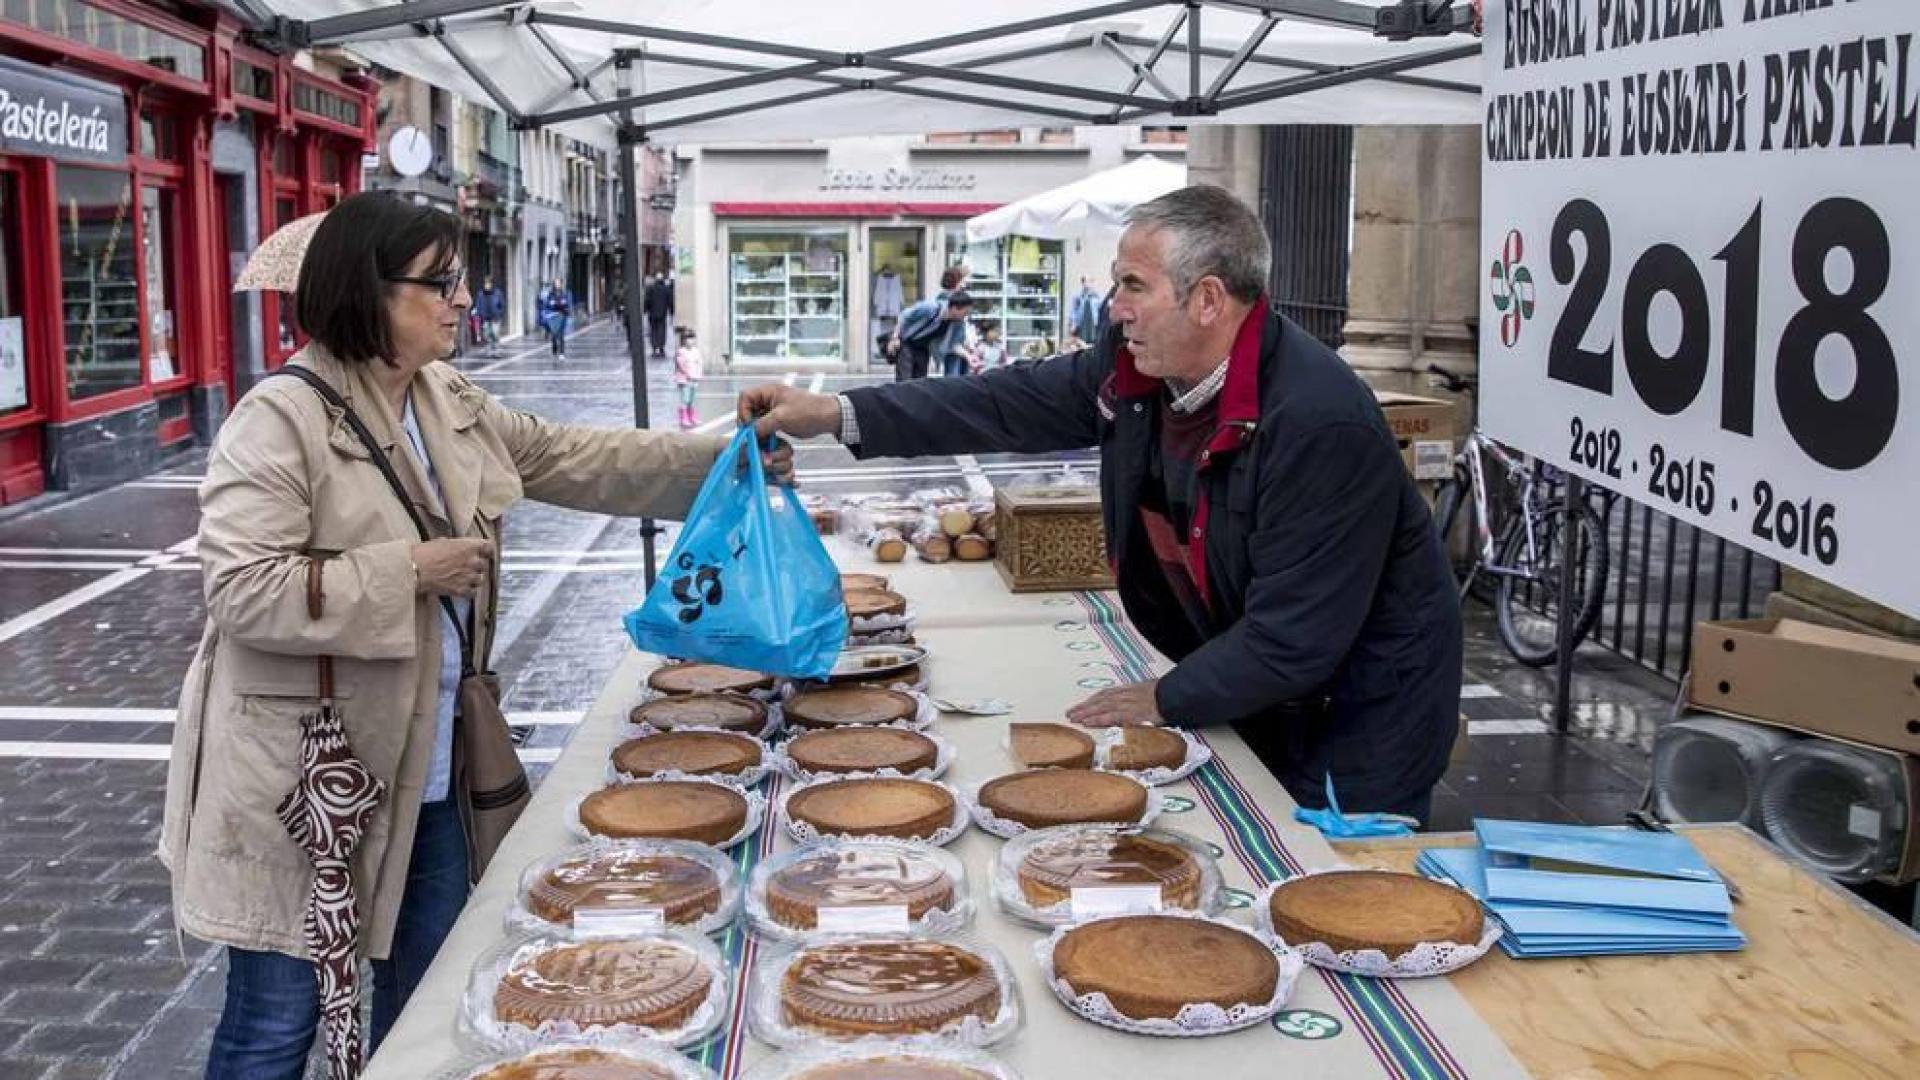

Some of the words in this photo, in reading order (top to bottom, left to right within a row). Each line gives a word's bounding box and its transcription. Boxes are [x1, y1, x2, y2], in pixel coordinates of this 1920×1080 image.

[1487, 86, 1573, 161] CAMPEON
[1582, 81, 1611, 158] DE
[1761, 34, 1918, 154] PASTEL
[1548, 196, 1899, 470] 2018
[1570, 416, 1621, 479] 2012
[1648, 443, 1714, 516] 2015
[1752, 479, 1838, 566] 2016
